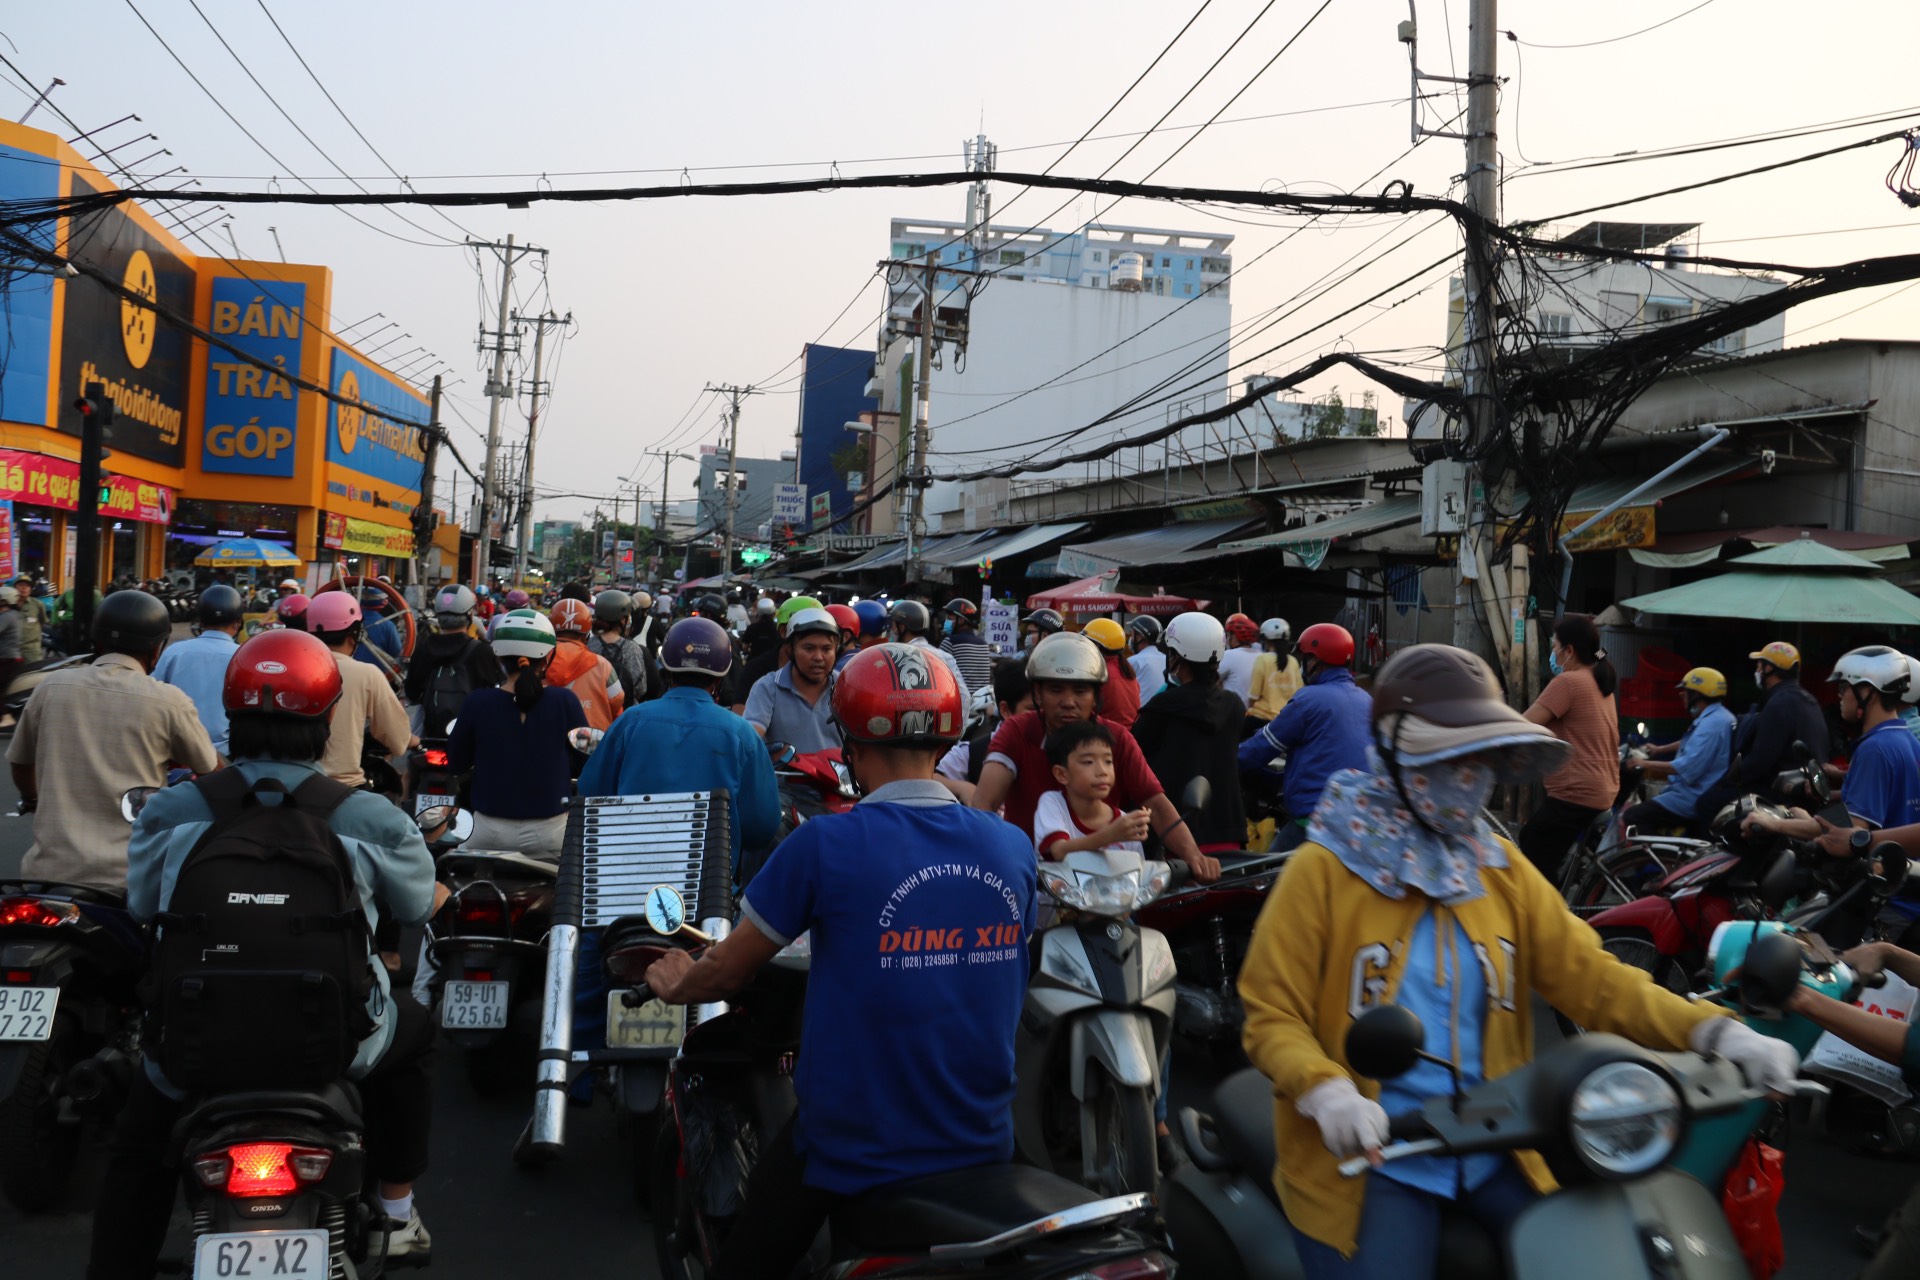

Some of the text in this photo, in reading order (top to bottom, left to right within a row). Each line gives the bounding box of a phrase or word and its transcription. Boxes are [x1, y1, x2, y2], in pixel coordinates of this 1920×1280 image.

[213, 295, 300, 340] BÁN
[212, 354, 293, 401] TRẢ
[205, 416, 293, 460] GÓP
[1072, 602, 1116, 612] BIA SAIGON
[1157, 605, 1185, 613] SAIGON
[879, 901, 897, 928] CTY
[891, 874, 920, 903] TNHH
[918, 864, 962, 882] MTV-TM
[965, 864, 980, 880] VÀ
[983, 871, 1003, 892] GIA
[879, 925, 964, 953] DŨNG
[901, 956, 922, 970] (028)
[924, 953, 958, 967] 22458581
[454, 984, 497, 1003] 59-U1
[446, 1005, 502, 1025] 425.64
[217, 1238, 308, 1277] 62-X2
